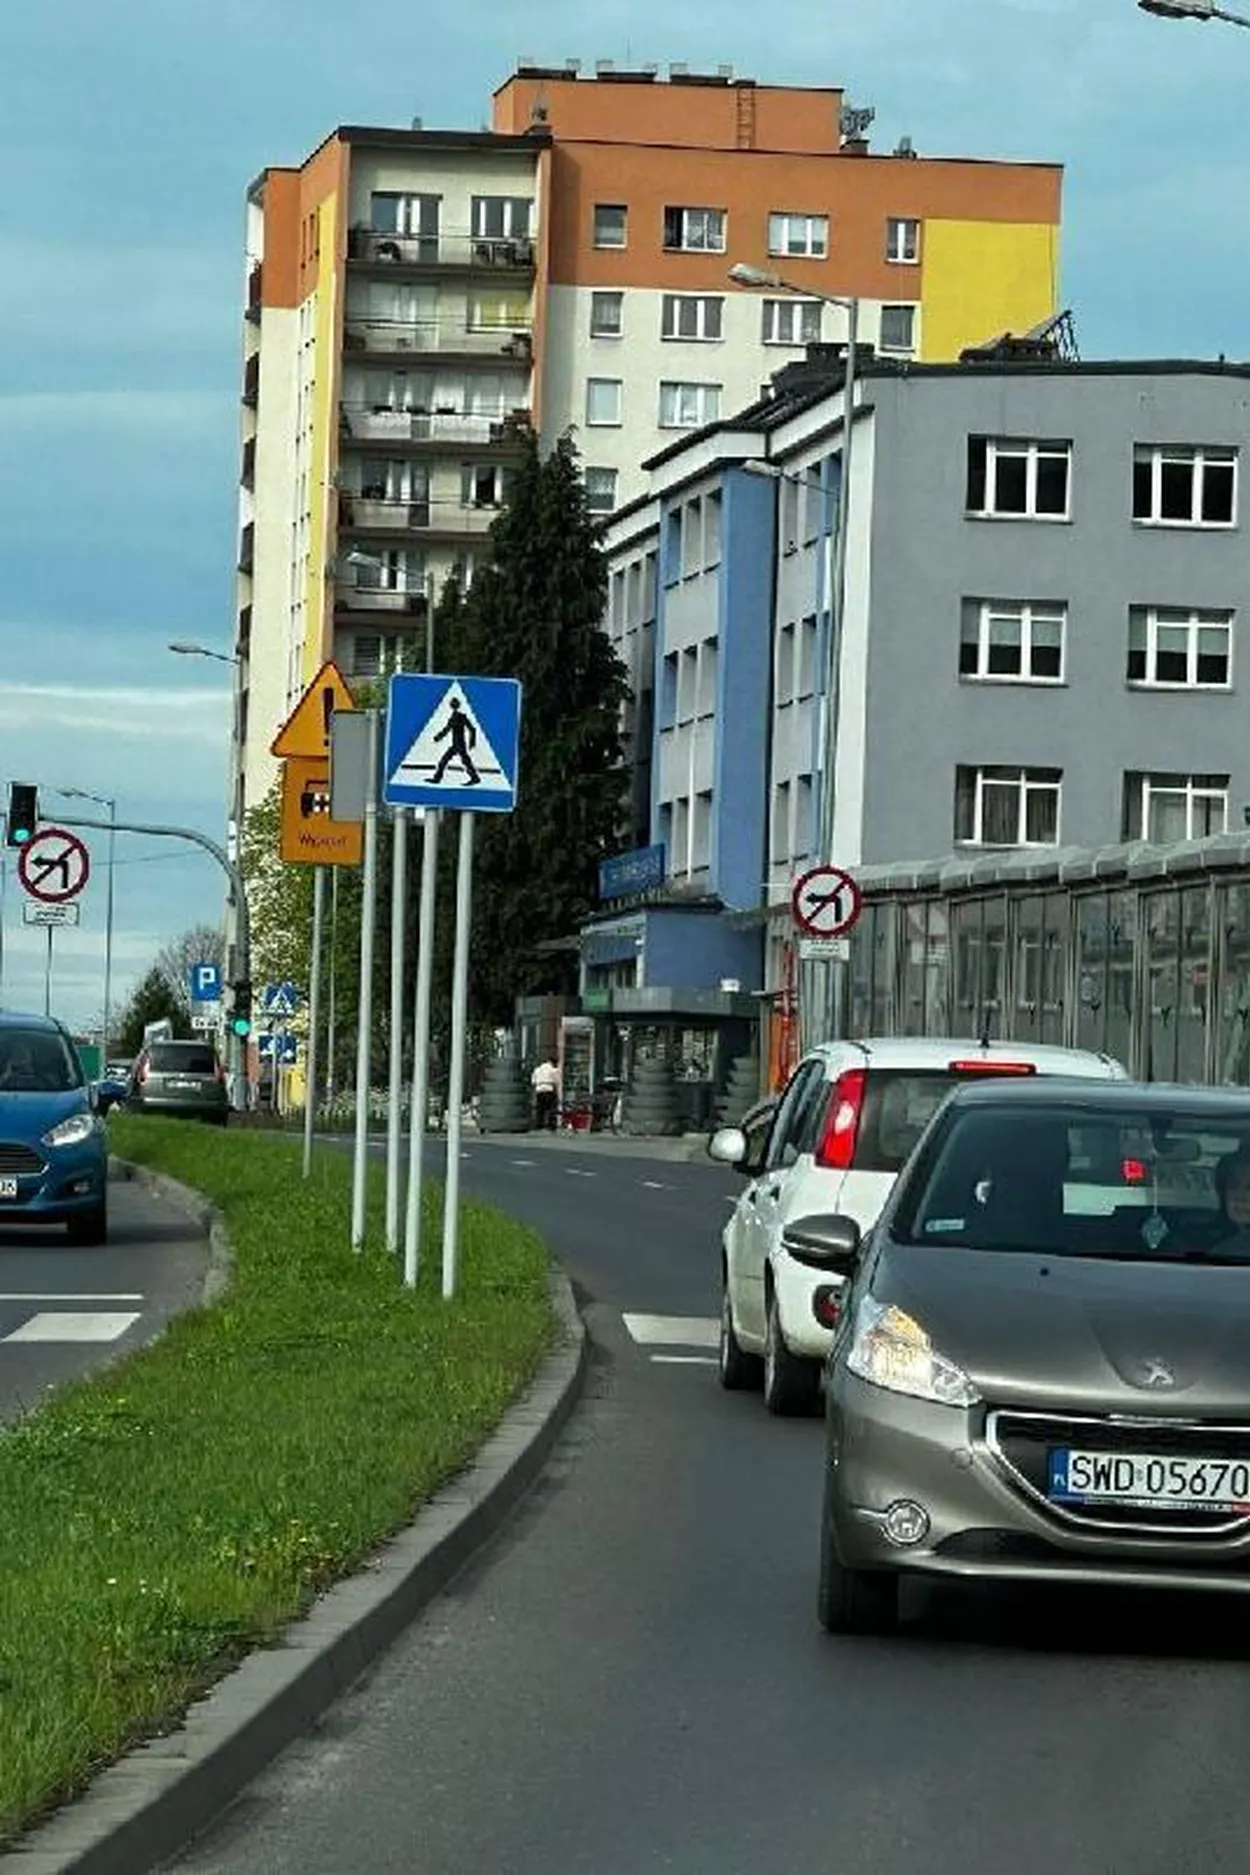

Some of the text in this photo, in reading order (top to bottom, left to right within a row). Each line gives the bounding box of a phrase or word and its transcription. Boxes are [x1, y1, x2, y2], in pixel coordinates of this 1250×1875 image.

[199, 967, 216, 991] P
[1071, 1456, 1250, 1499] SWD 05670
